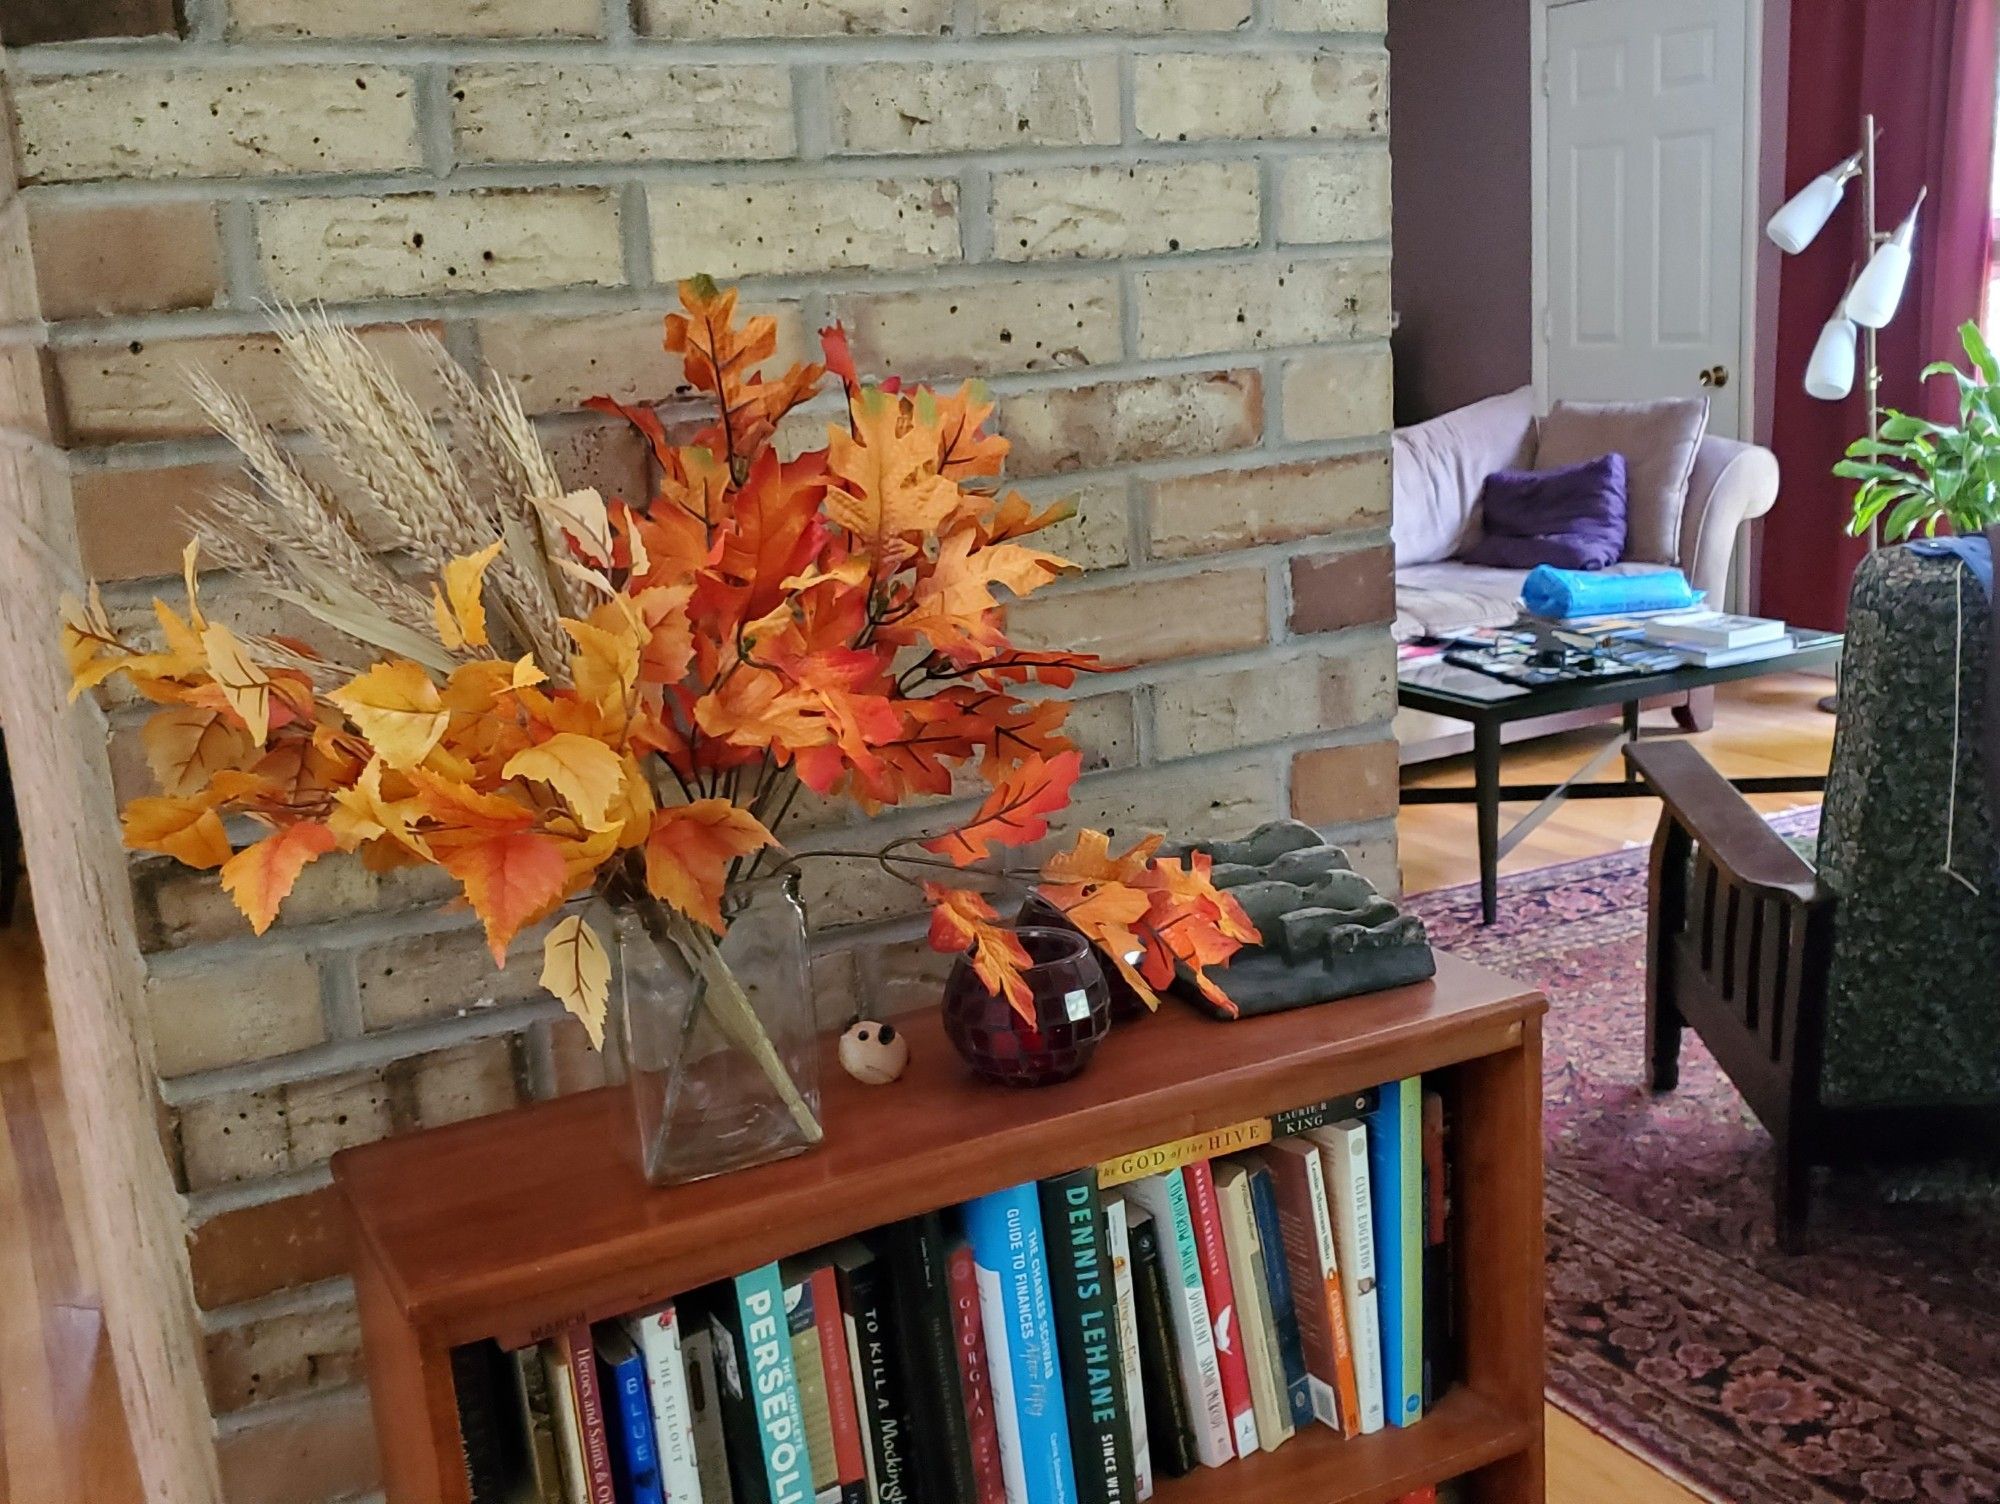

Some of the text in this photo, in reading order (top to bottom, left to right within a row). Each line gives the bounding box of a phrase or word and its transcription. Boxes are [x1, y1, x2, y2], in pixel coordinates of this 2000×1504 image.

[1278, 1105, 1317, 1123] LAURIE
[1286, 1115, 1323, 1133] KING
[1121, 1151, 1166, 1174] GOD
[1170, 1147, 1183, 1160] of
[1186, 1142, 1204, 1155] the
[1208, 1125, 1260, 1151] HIVE
[1355, 1176, 1371, 1269] CLYDE EDGERTON
[1169, 1180, 1210, 1347] TOMORROW WILL BE DIFFERENT
[865, 1307, 879, 1334] TO
[1006, 1208, 1047, 1417] GUIDE TO FINANCES After Fifty
[1028, 1227, 1054, 1380] THE CHARLES SCHWAB
[1065, 1185, 1117, 1424] DENNIS LEHANE
[577, 1348, 592, 1399] Heroes
[869, 1342, 887, 1390] KILL
[584, 1400, 601, 1425] and
[626, 1377, 650, 1461] BLUE
[659, 1356, 683, 1463] THE SELLOUT
[781, 1355, 805, 1453] THE COMPLETE
[877, 1398, 890, 1411] A
[588, 1428, 605, 1469] Saints
[1101, 1433, 1117, 1473] SINCE
[595, 1471, 609, 1484] &
[1106, 1476, 1121, 1498] WE
